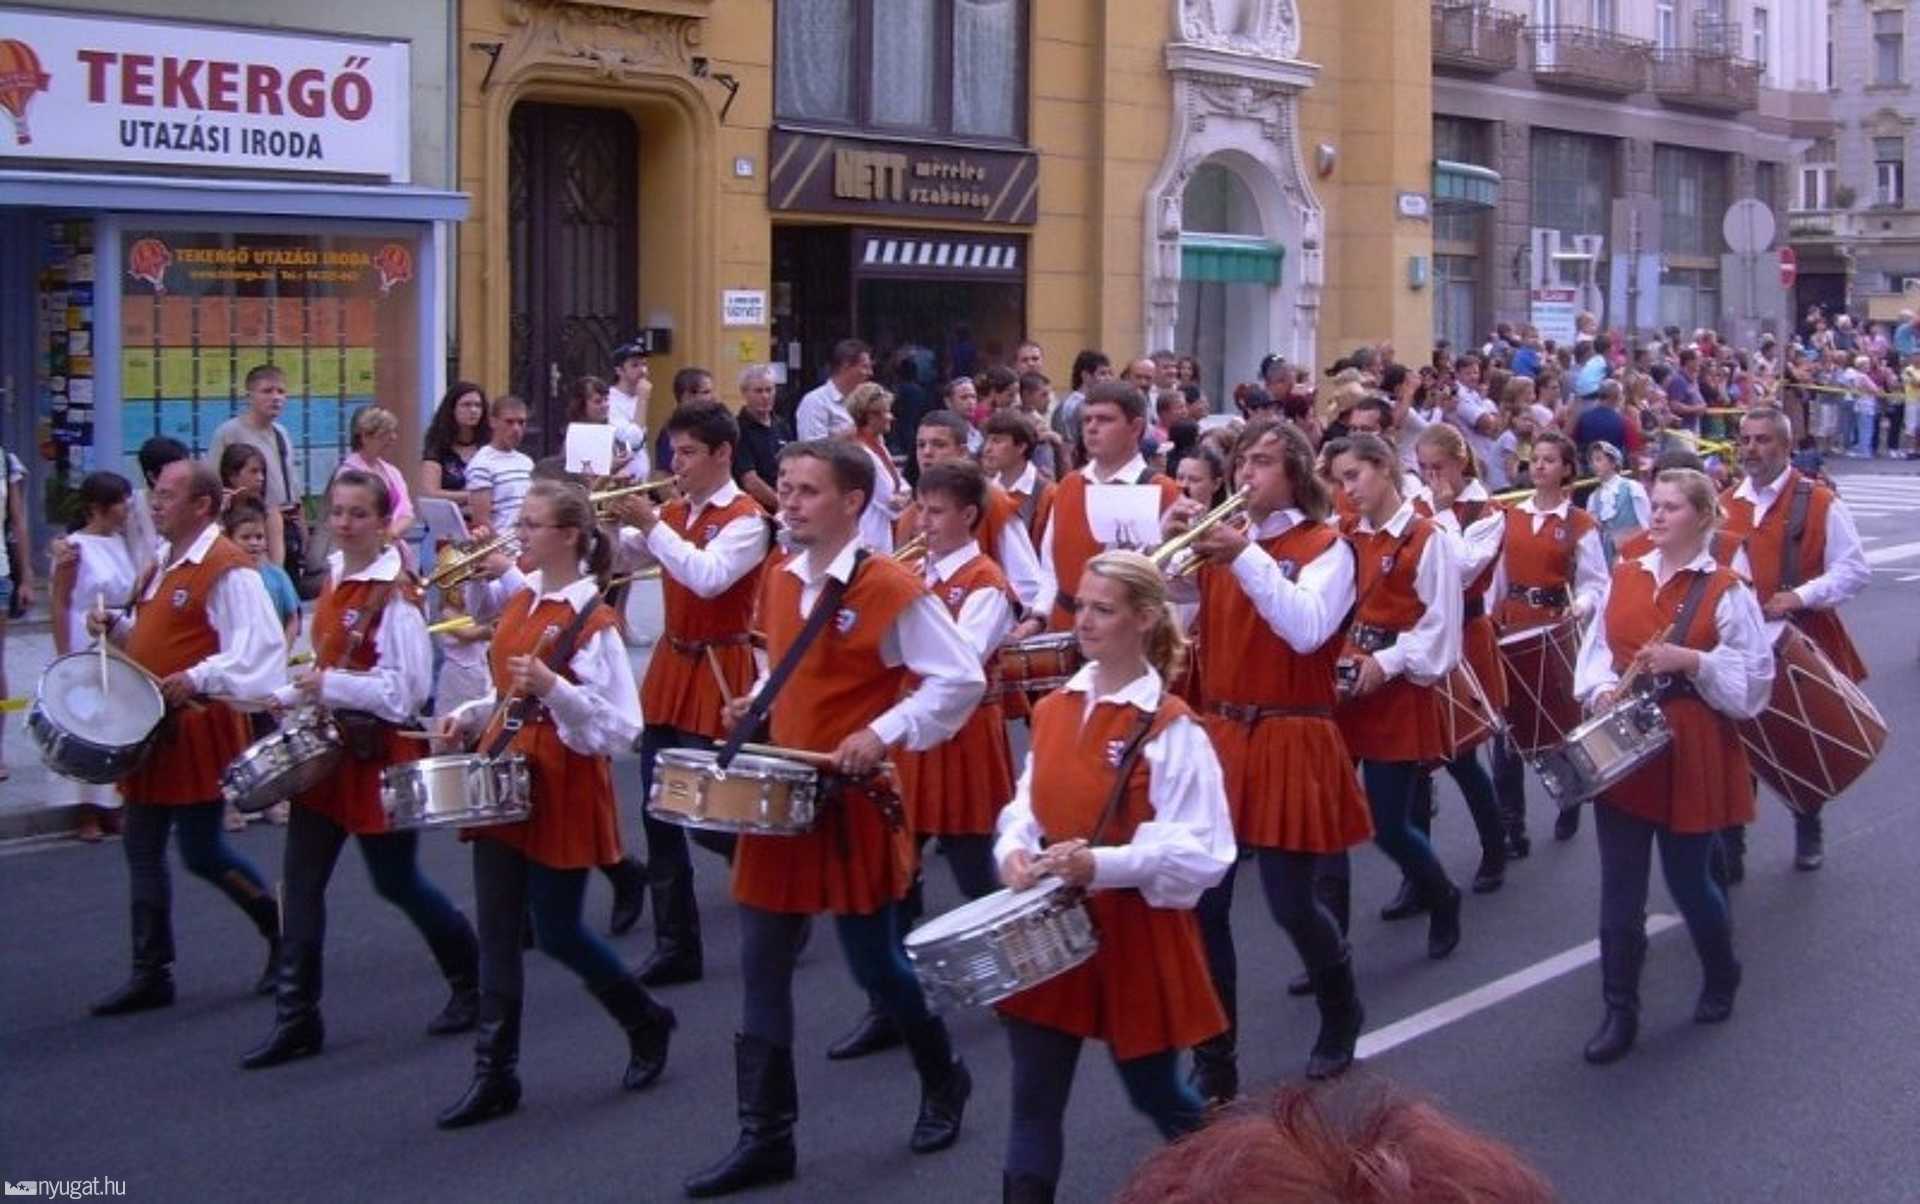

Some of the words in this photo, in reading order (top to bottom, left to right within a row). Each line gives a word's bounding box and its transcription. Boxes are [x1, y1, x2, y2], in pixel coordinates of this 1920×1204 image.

[77, 50, 374, 121] TEKERGŐ
[119, 114, 230, 154] UTAZÁSI
[241, 128, 323, 159] IRODA
[834, 149, 907, 201] NETT
[253, 247, 317, 265] UTAZÁSI
